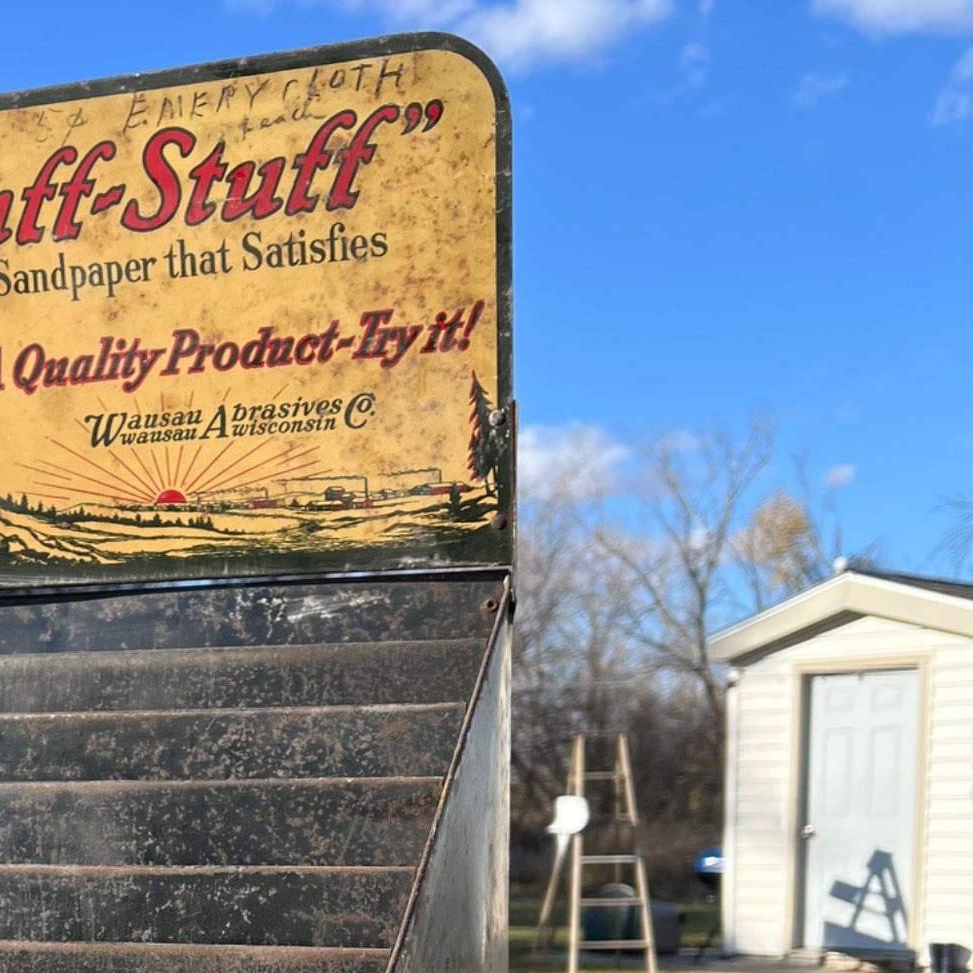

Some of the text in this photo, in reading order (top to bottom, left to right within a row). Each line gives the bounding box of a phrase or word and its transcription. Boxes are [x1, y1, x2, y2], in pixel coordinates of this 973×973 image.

[166, 237, 233, 280] that
[241, 223, 389, 272] Satisfies
[13, 336, 166, 396] Quality
[421, 300, 486, 355] it!
[84, 391, 377, 448] Wausau Abrasives Co.
